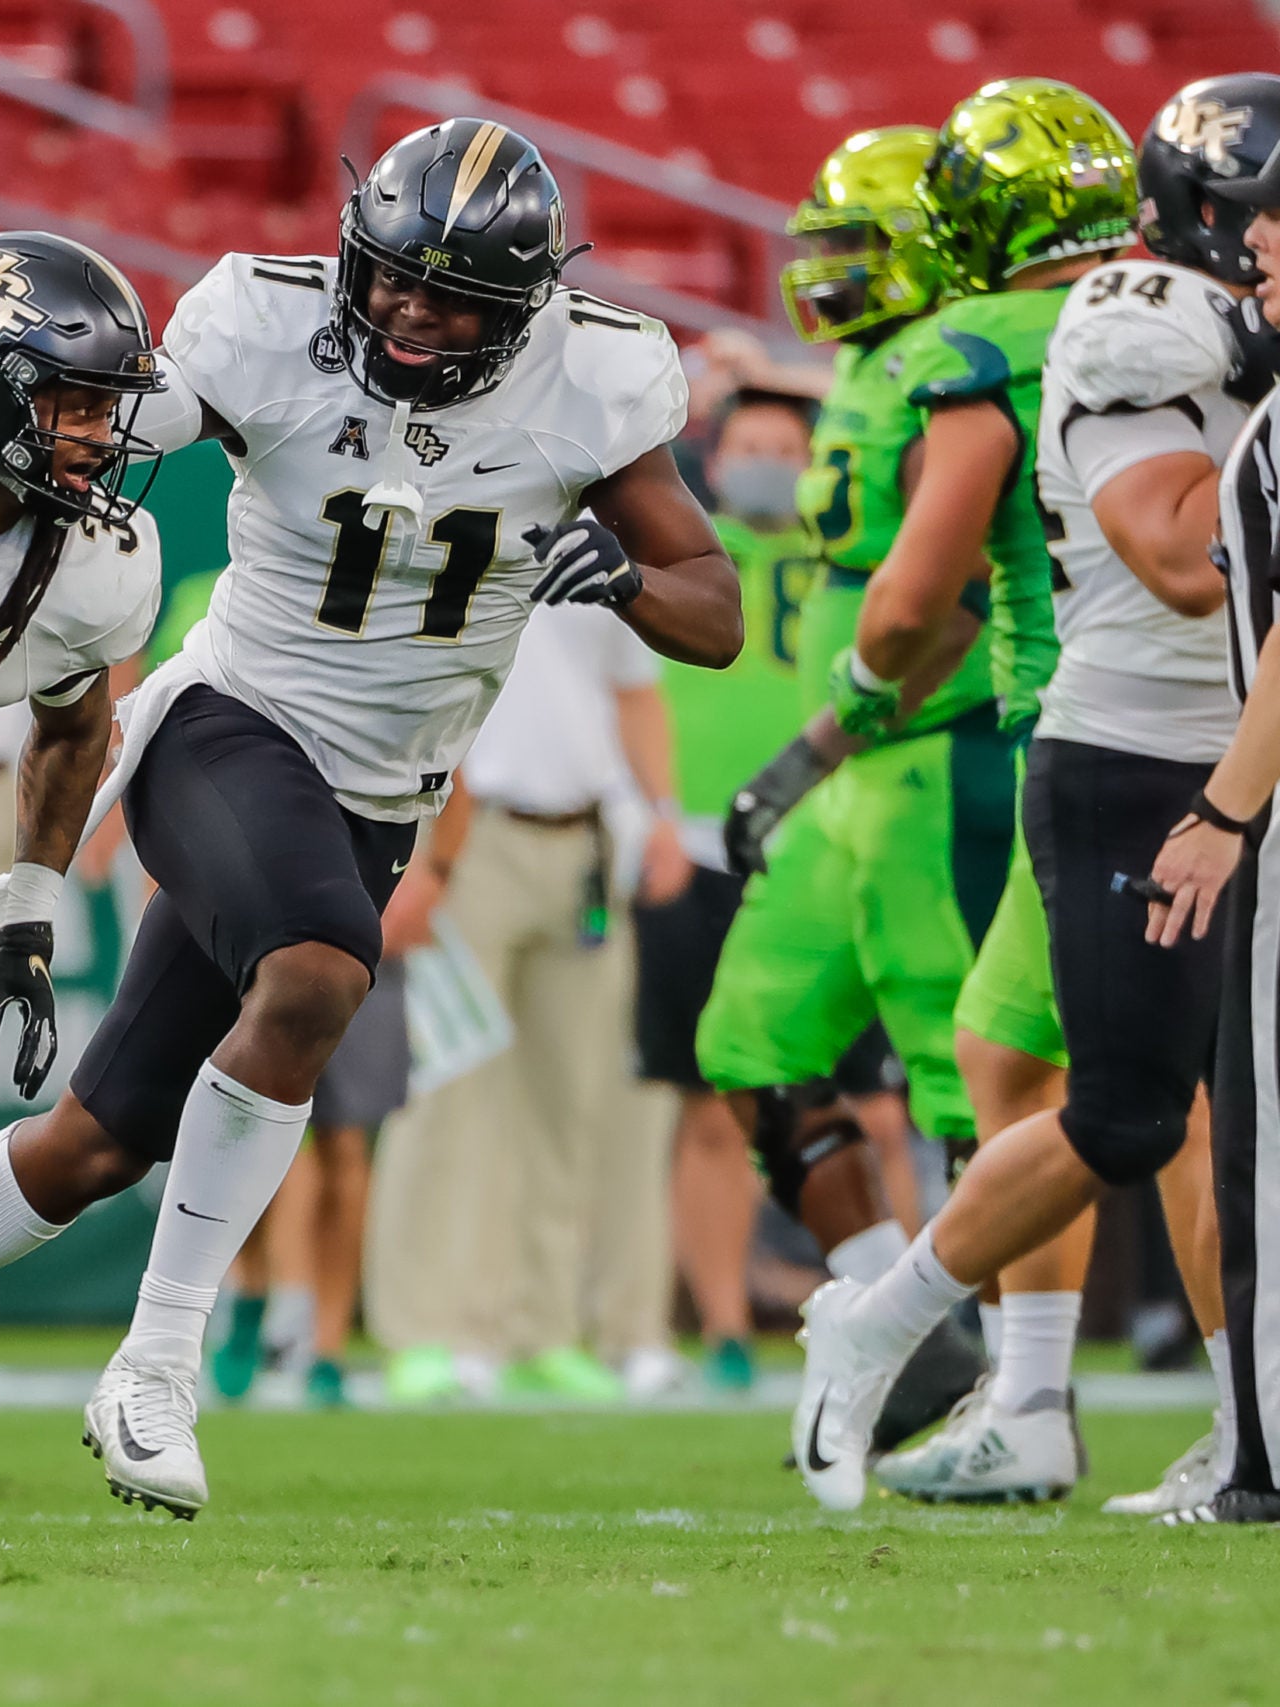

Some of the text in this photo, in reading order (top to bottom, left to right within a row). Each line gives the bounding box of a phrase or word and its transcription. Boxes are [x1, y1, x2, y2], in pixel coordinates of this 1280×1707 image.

[420, 246, 452, 268] 305
[315, 337, 342, 360] BL
[404, 422, 450, 467] UCF
[313, 485, 504, 645] 11
